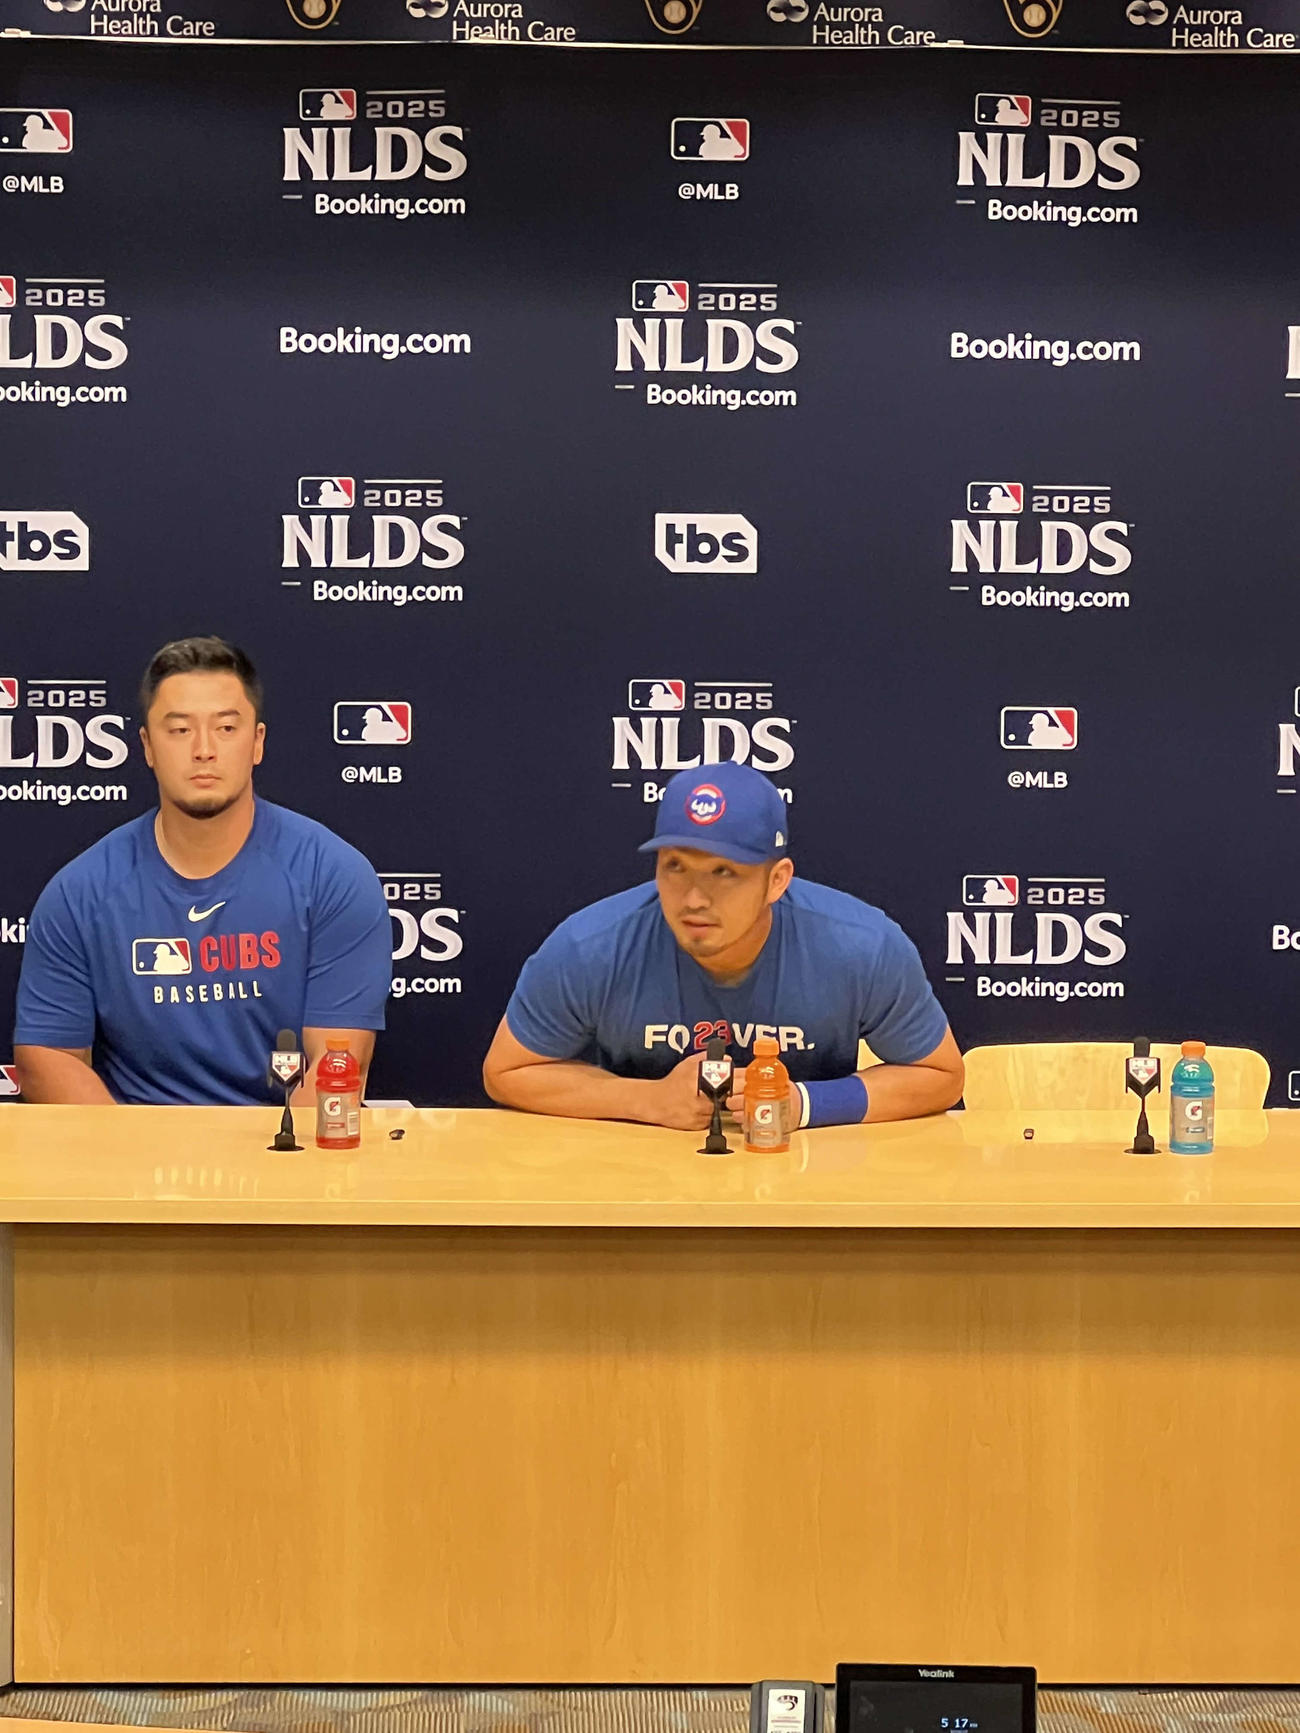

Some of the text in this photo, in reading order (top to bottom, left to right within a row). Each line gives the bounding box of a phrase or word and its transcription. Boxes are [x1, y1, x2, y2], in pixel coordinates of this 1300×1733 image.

[91, 0, 162, 12] Aurora
[453, 0, 523, 18] Aurora
[813, 4, 884, 22] Aurora
[1173, 5, 1242, 24] Aurora
[90, 14, 215, 36] Health Care
[452, 19, 576, 41] Health Care
[812, 23, 936, 46] Health Care
[1171, 26, 1295, 48] Health Care
[366, 100, 446, 119] 2025
[1040, 109, 1121, 128] 2025
[282, 126, 467, 181] NLDS
[957, 132, 1141, 190] NLDS
[2, 176, 64, 193] @MLB
[678, 183, 740, 200] @MLB
[315, 193, 466, 219] Booking.com
[987, 199, 1138, 227] Booking.com
[25, 288, 106, 307] 2025
[697, 293, 778, 312] 2025
[0, 314, 128, 370] LDS
[279, 326, 471, 360] Booking.com
[614, 318, 799, 374] NLDS
[950, 332, 1141, 367] Booking.com
[0, 381, 127, 407] oking.com
[646, 383, 797, 411] Booking.com
[363, 489, 443, 507] 2025
[1031, 495, 1111, 514] 2025
[0, 521, 81, 561] tbs
[281, 514, 465, 569] NLDS
[665, 523, 750, 564] tbs
[950, 519, 1132, 576] NLDS
[313, 579, 464, 607] Booking.com
[981, 585, 1130, 612] Booking.com
[27, 689, 107, 707] 2025
[693, 692, 773, 710] 2025
[0, 714, 129, 769] LDS
[611, 716, 795, 772] NLDS
[341, 766, 403, 783] @MLB
[1007, 770, 1069, 789] @MLB
[0, 779, 128, 806] ooking.com
[383, 883, 442, 900] 025
[1027, 887, 1106, 905] 2025
[388, 907, 463, 961] DS
[945, 911, 1127, 966] NLDS
[200, 931, 281, 973] CUBS
[153, 980, 263, 1004] BASEBALL
[976, 976, 1125, 1002] Booking.com
[918, 1669, 955, 1678] Yealink
